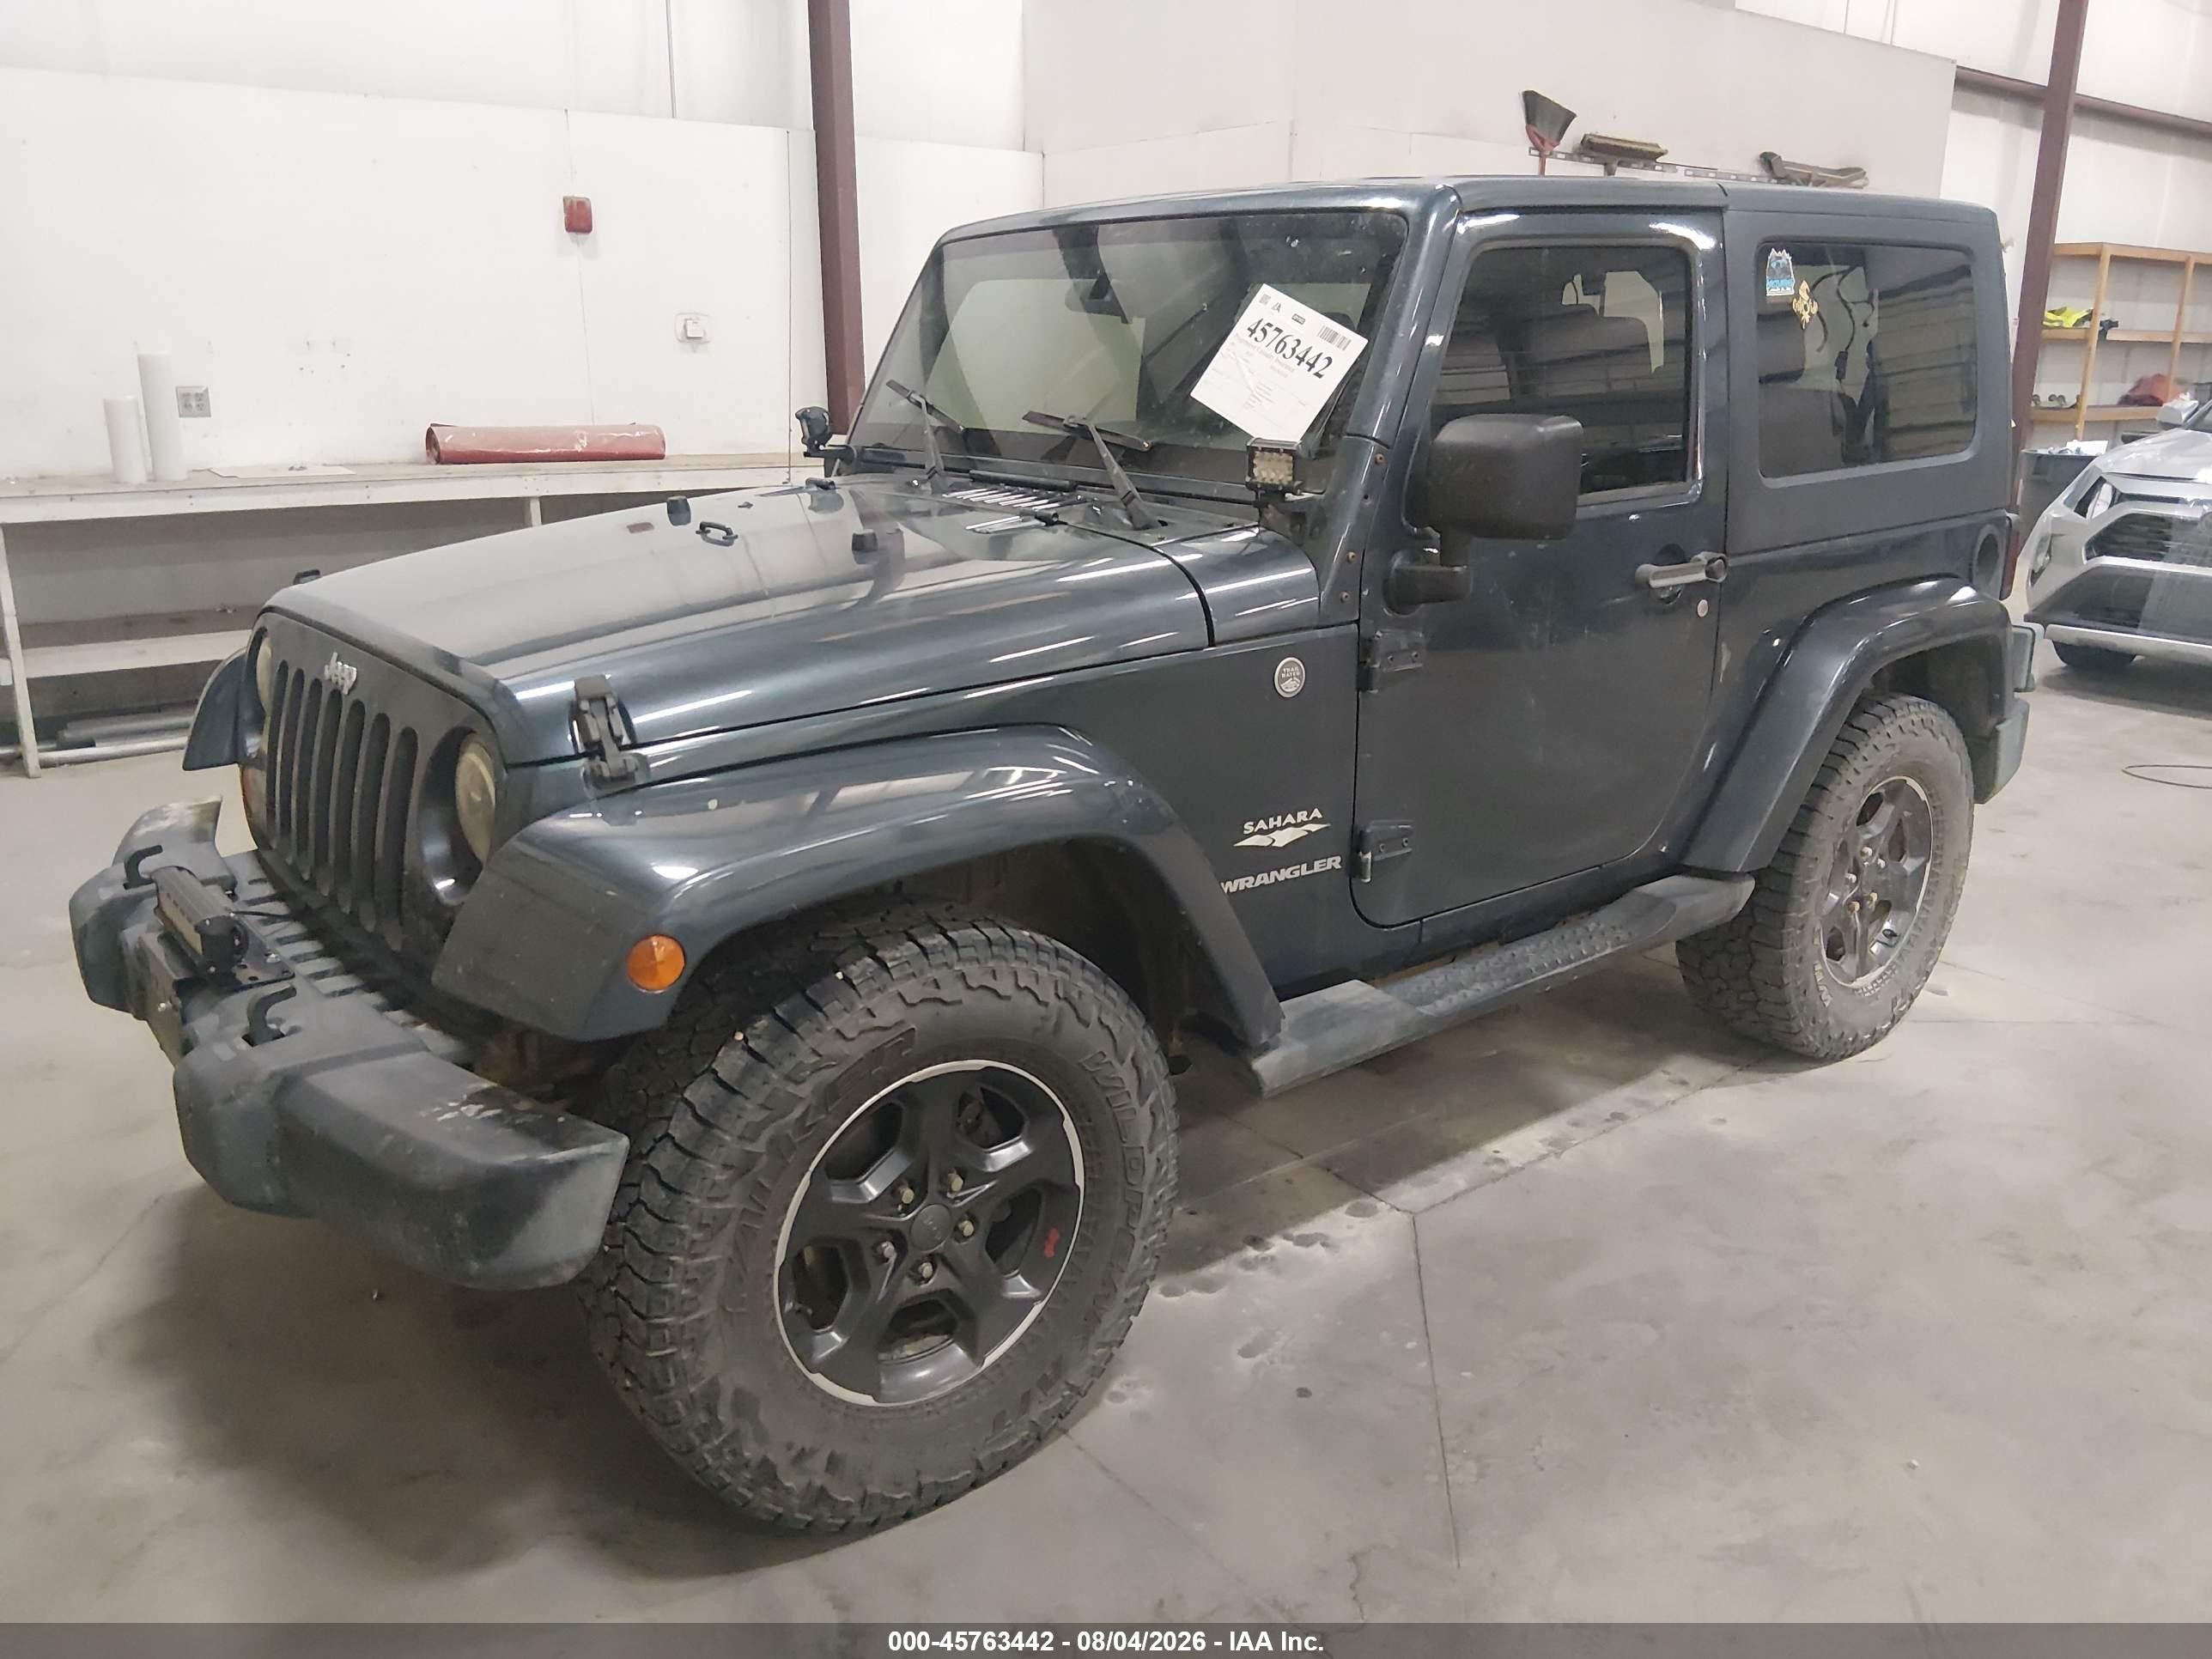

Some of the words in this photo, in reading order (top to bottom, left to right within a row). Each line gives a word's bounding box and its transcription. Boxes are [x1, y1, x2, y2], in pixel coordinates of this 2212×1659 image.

[1247, 318, 1334, 379] 45763442
[1243, 808, 1322, 835] SAHARA
[1221, 855, 1342, 894] WRANGLER
